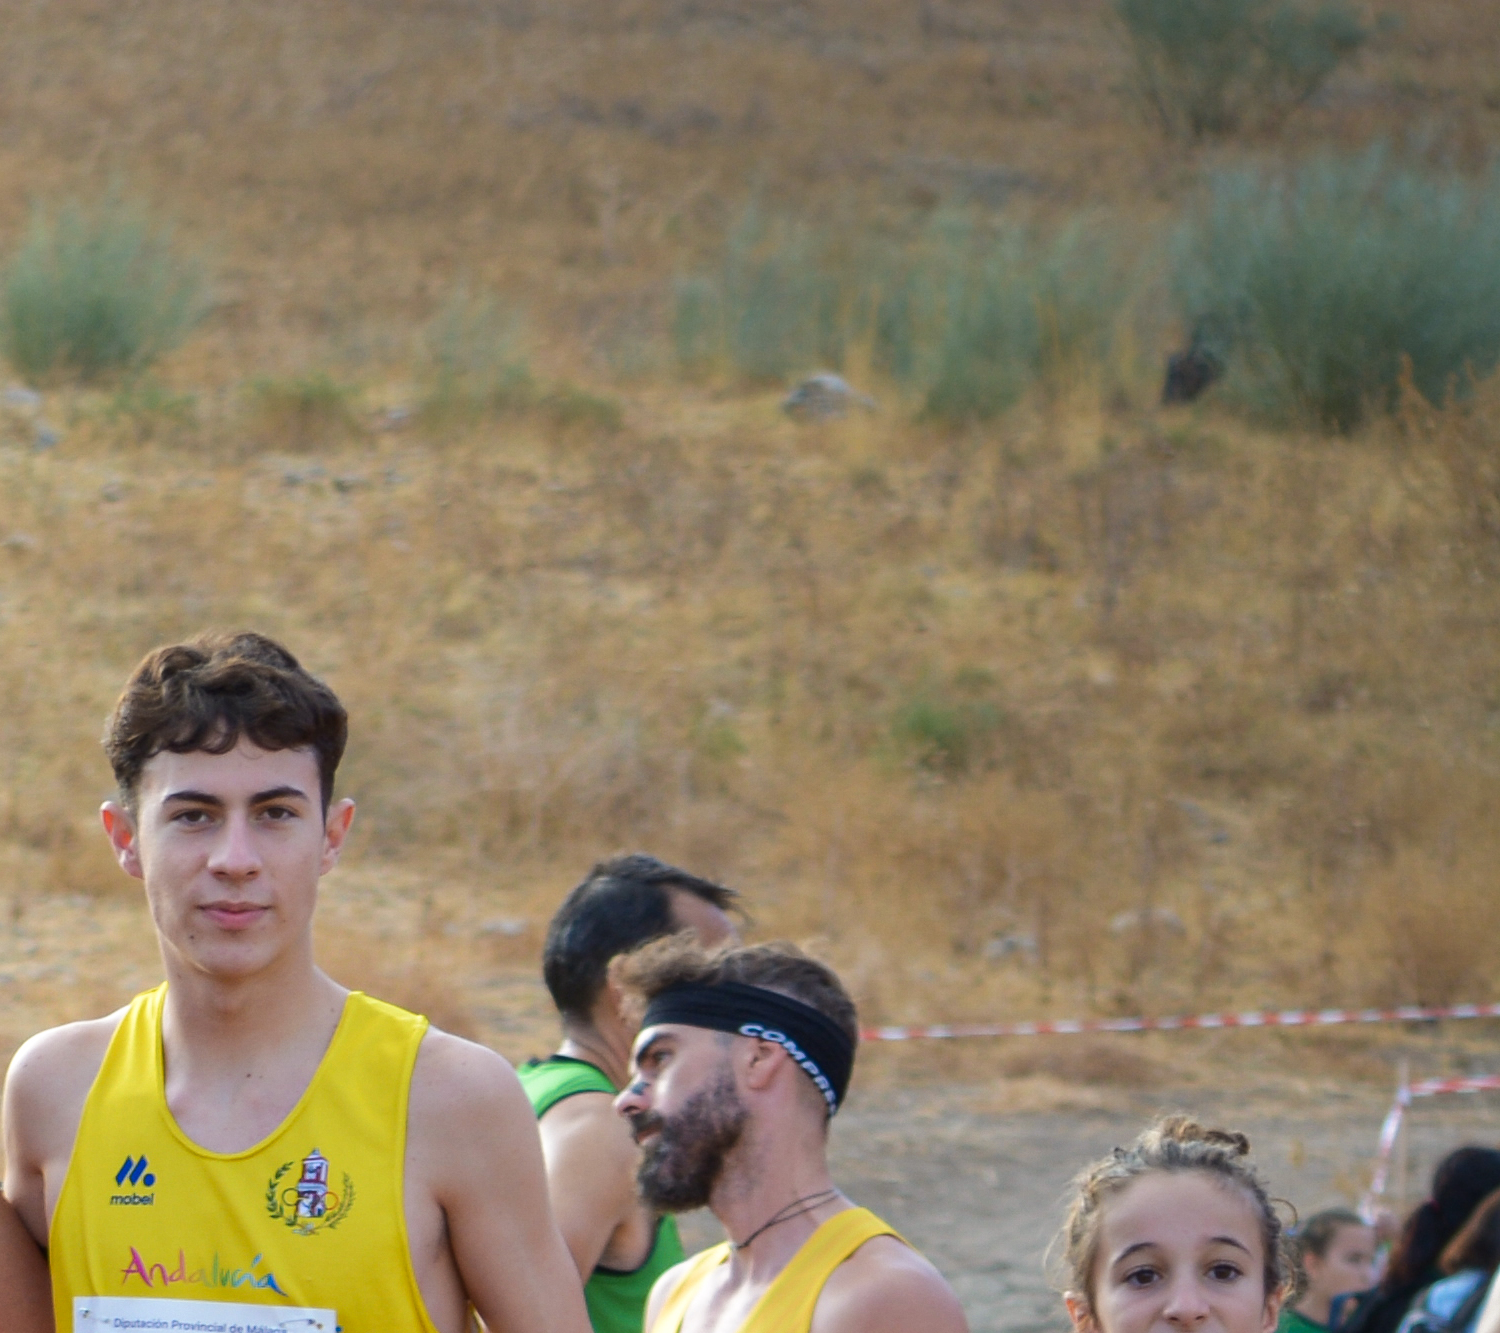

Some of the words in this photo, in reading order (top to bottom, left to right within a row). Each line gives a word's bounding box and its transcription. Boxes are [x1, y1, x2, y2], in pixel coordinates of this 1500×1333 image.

[121, 1245, 288, 1297] Andalucía
[113, 1316, 168, 1331] Diputación
[171, 1319, 227, 1333] Provincial
